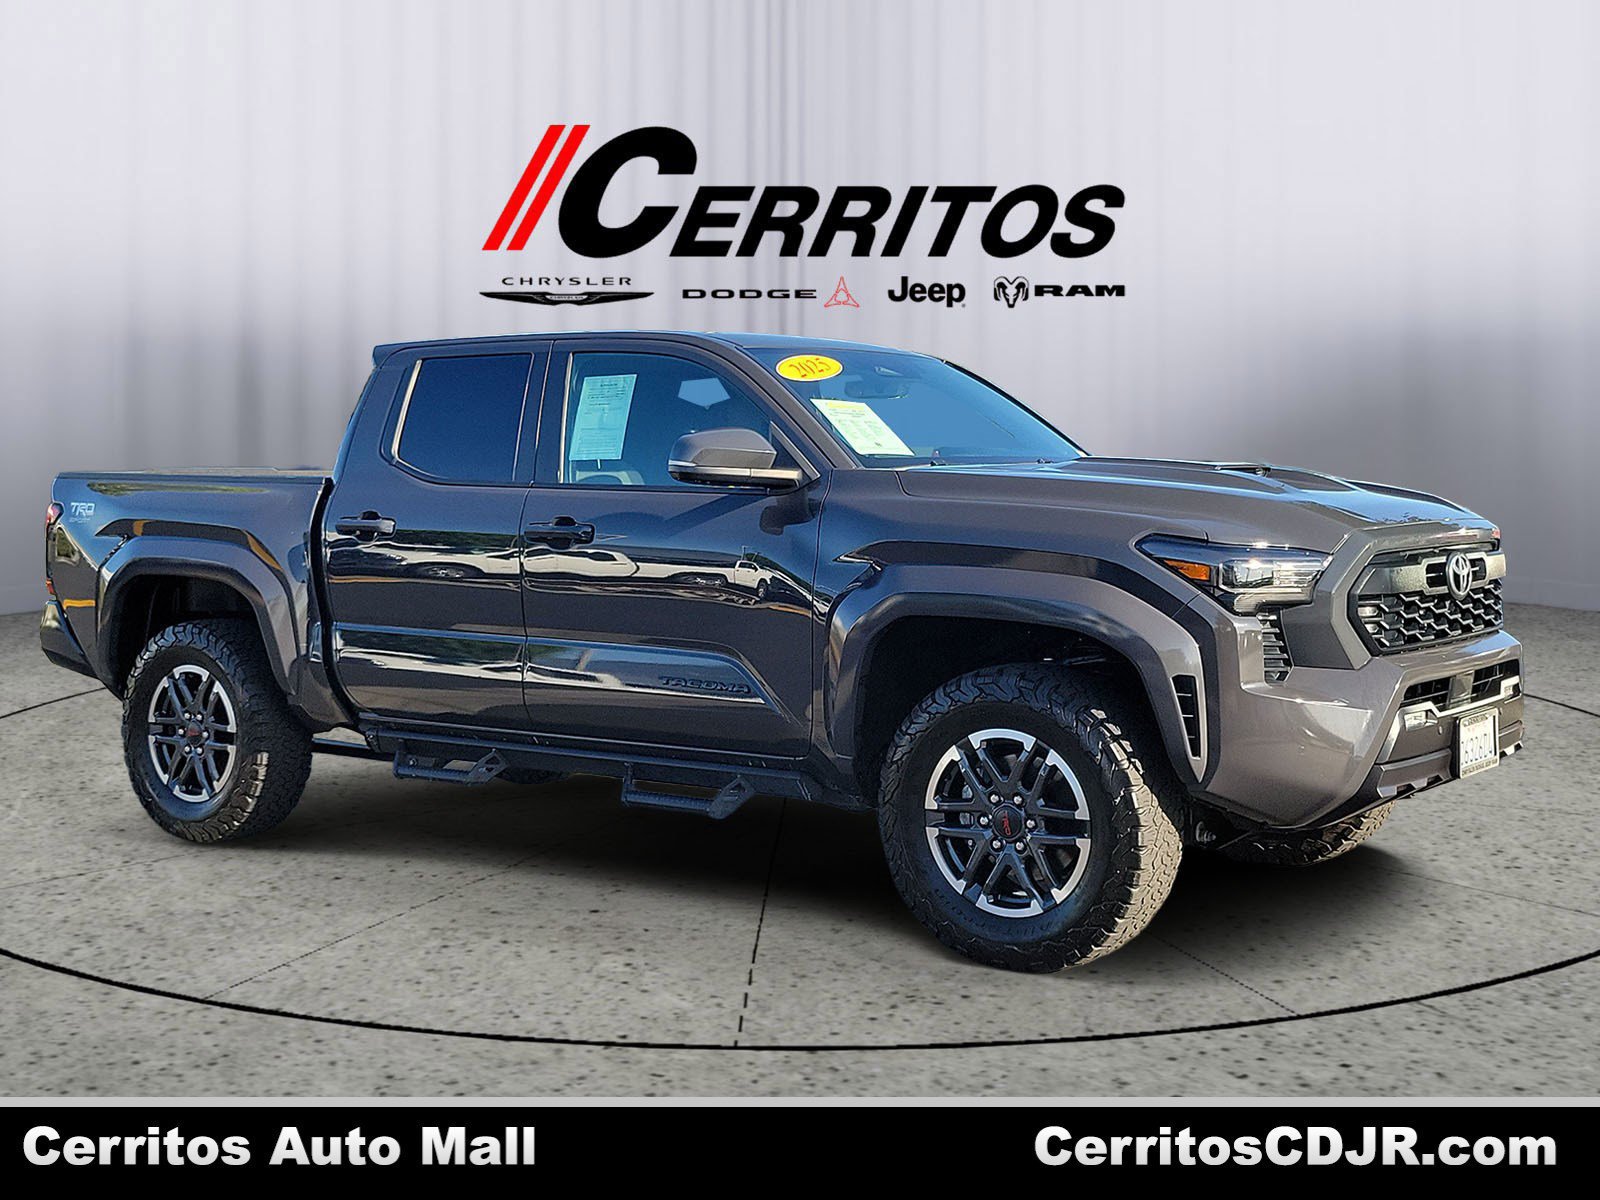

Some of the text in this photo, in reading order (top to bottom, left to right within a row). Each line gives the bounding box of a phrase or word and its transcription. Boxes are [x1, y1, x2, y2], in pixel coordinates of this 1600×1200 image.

[788, 357, 832, 379] 2025
[70, 502, 96, 517] TRD
[659, 675, 752, 694] TACOMA
